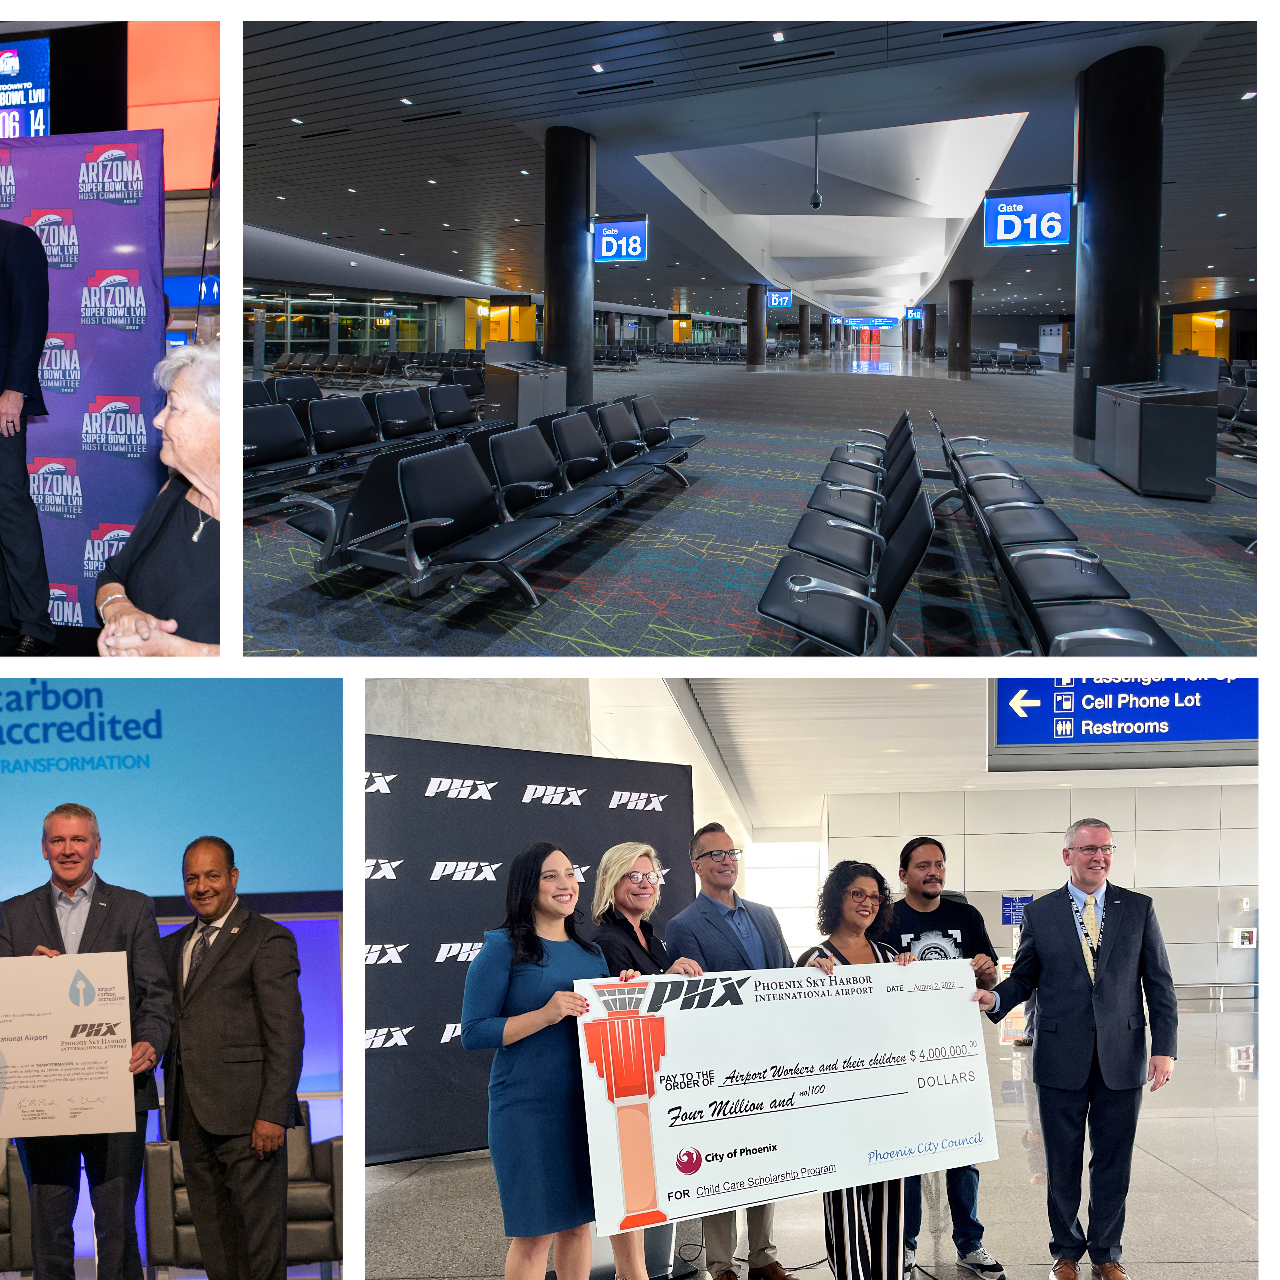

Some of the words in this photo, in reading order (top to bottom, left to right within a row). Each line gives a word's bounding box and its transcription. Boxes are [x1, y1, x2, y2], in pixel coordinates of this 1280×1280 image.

[0, 90, 26, 106] BOWL
[29, 88, 45, 104] LVII
[0, 111, 20, 138] 06
[30, 109, 45, 137] 14
[79, 160, 143, 183] ARIZONA
[78, 183, 102, 192] SUPER
[104, 182, 126, 191] BOWL
[128, 181, 143, 190] LVII
[78, 192, 98, 200] HOST
[99, 191, 144, 200] COMMITTEE
[998, 204, 1024, 212] Gate
[997, 212, 1062, 240] D16
[602, 236, 642, 256] D18
[81, 286, 146, 308] ARIZONA
[772, 296, 788, 306] D17
[82, 412, 146, 434] ARIZONA
[1082, 694, 1112, 710] Cell
[1118, 693, 1170, 708] Phone
[1174, 692, 1201, 707] Lot
[1082, 720, 1169, 734] Restrooms
[424, 778, 498, 800] PHX
[522, 784, 588, 806] PHX
[608, 790, 668, 812] PHX
[430, 861, 502, 882] PHX
[647, 976, 752, 1013] PHX
[754, 980, 803, 992] PHOENIX
[806, 976, 826, 988] SKY
[828, 975, 872, 986] HARBOR
[754, 990, 832, 1002] INTERNATIONAL
[834, 986, 874, 996] AIRPORT
[886, 984, 904, 993] DATE
[24, 1034, 48, 1042] Airport
[70, 1022, 122, 1038] PHX
[660, 1074, 678, 1084] PAY
[681, 1072, 694, 1080] TO
[696, 1070, 714, 1079] THE
[664, 1080, 700, 1092] ORDER
[702, 1076, 714, 1086] OF
[723, 1068, 768, 1085] Airport
[770, 1062, 814, 1078] Workers
[818, 1059, 838, 1072] and
[842, 1056, 864, 1070] their
[868, 1052, 907, 1066] children
[918, 1071, 976, 1088] DOLLARS
[668, 1106, 704, 1128] Four
[708, 1098, 764, 1118] Million
[770, 1092, 795, 1108] and
[705, 1152, 724, 1162] City
[726, 1150, 738, 1158] of
[740, 1144, 778, 1156] Phoenix
[868, 1146, 916, 1163] Phoenix
[918, 1142, 938, 1154] City
[941, 1132, 984, 1150] Council
[668, 1190, 690, 1201] FOR
[696, 1184, 720, 1196] Child
[722, 1180, 744, 1192] Care
[748, 1170, 798, 1186] Scholarship
[800, 1164, 836, 1178] Program
